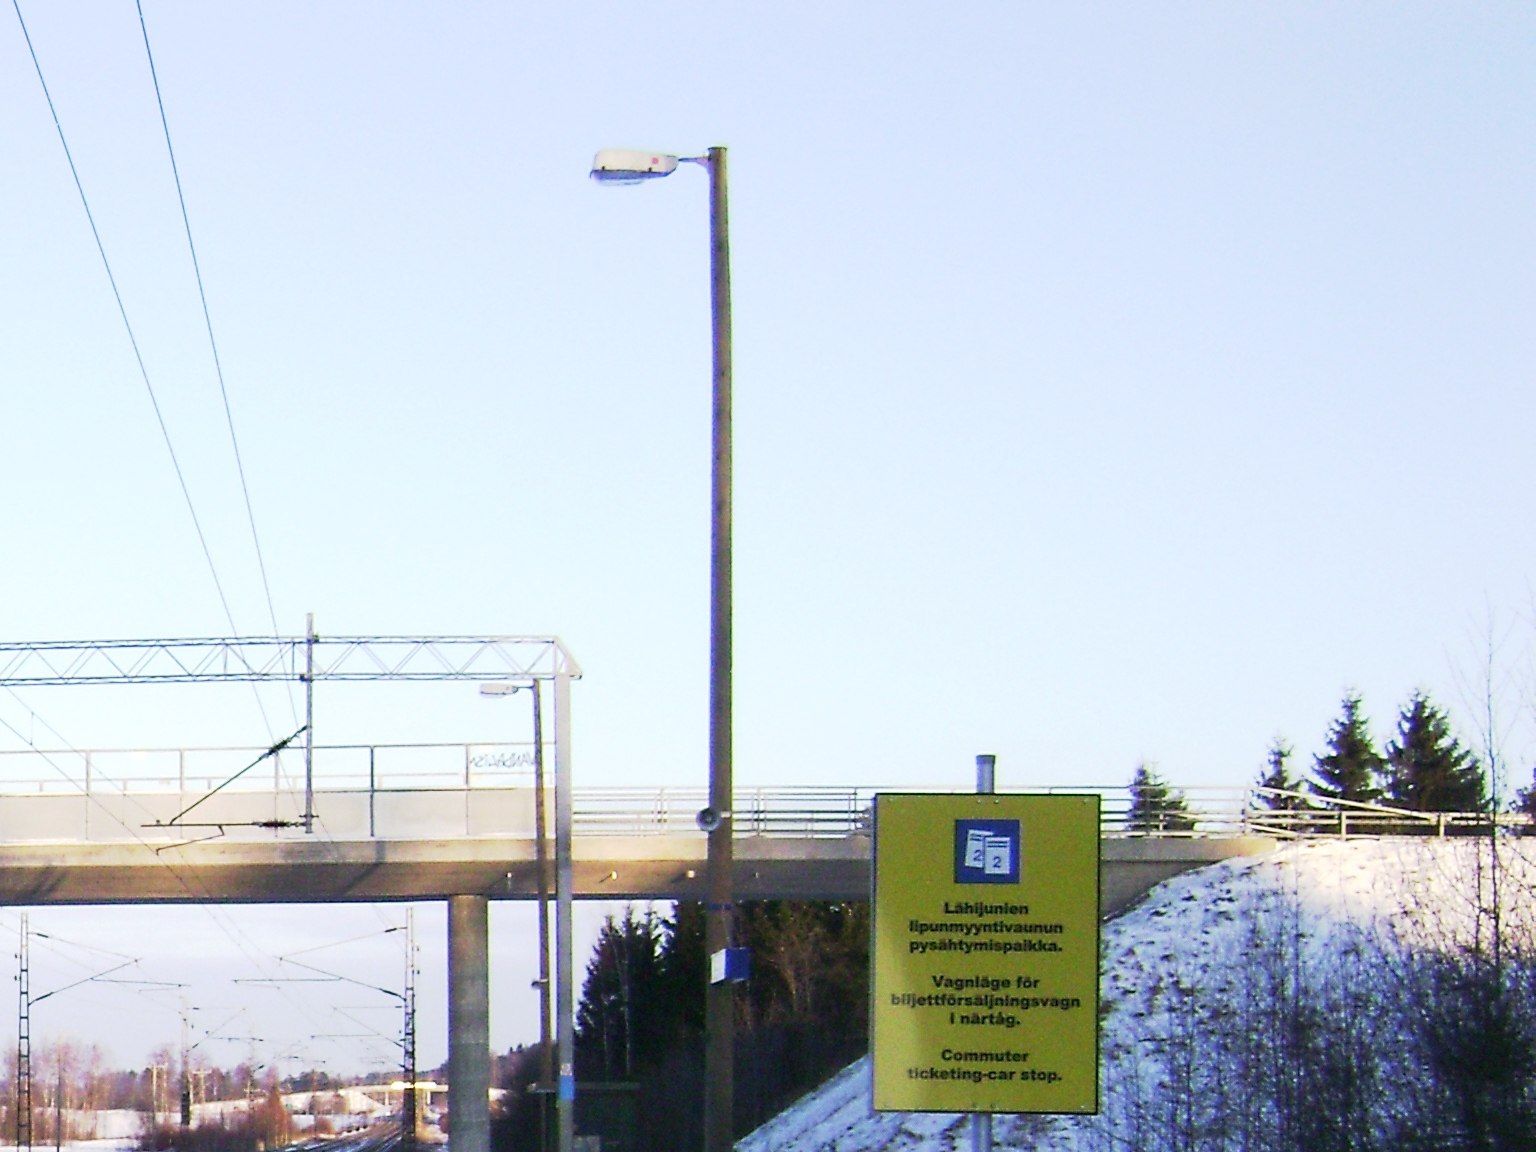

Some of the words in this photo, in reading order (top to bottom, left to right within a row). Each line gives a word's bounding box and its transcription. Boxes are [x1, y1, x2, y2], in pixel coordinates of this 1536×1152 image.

[973, 849, 982, 862] 2
[993, 856, 1002, 868] 2
[943, 902, 1029, 917] Lähijunien
[909, 920, 1063, 935] lipunmyyntivaunun
[909, 938, 1063, 953] pysähtymispaikka.
[932, 975, 1011, 990] Vagnläge
[1017, 976, 1040, 988] för
[891, 993, 1081, 1010] biljettförsäljningsvagn
[960, 1012, 1021, 1028] närtåg.
[941, 1049, 1028, 1062] Commuter
[907, 1068, 1016, 1082] ticketing-car
[1020, 1070, 1062, 1083] stop.
